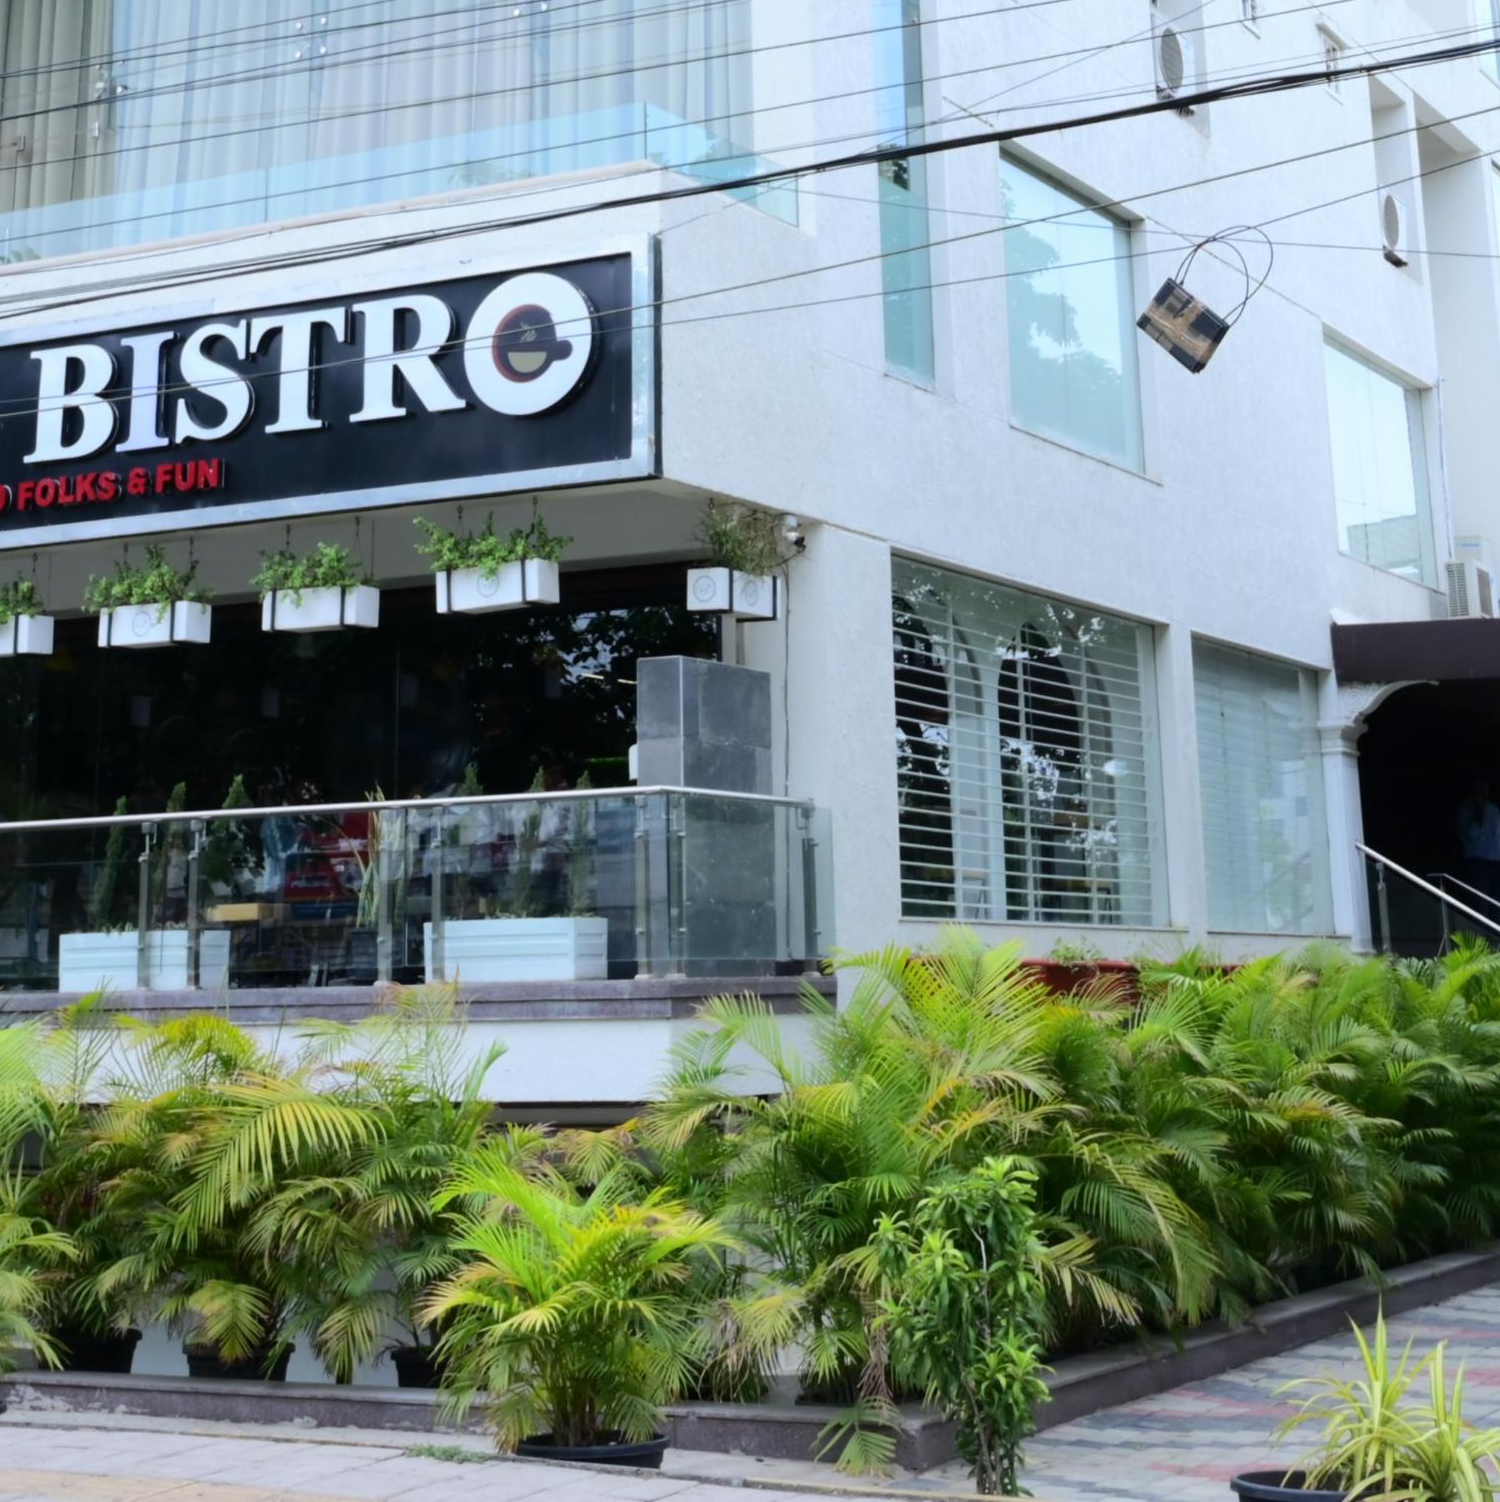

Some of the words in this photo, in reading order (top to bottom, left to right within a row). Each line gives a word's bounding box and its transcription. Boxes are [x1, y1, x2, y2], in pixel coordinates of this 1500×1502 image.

[23, 272, 594, 464] BISTRO
[18, 471, 120, 510] FOLKS
[127, 467, 147, 495] &
[155, 458, 224, 492] FUN
